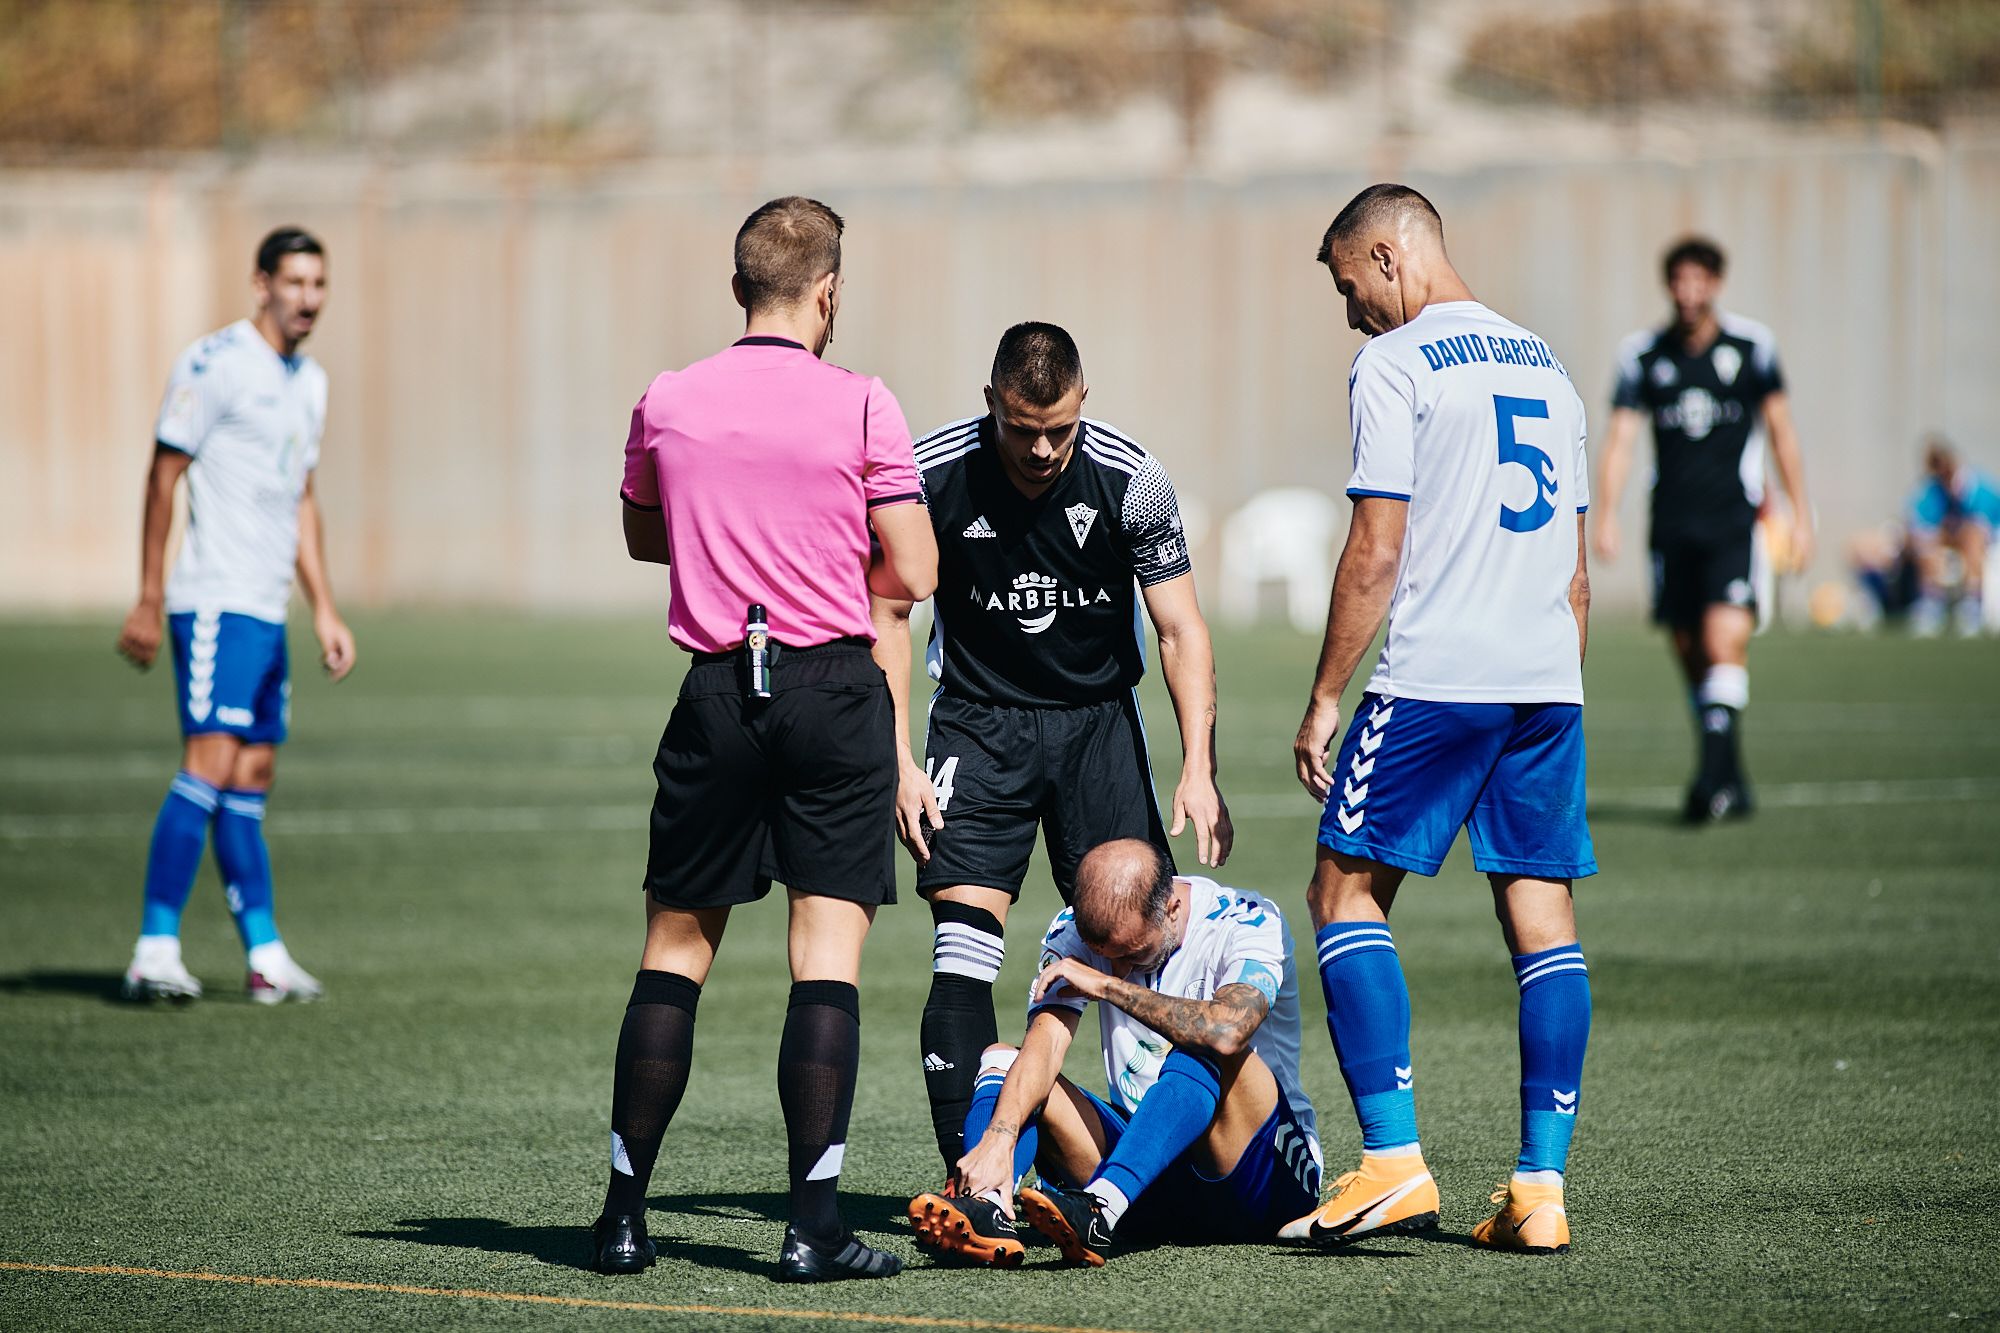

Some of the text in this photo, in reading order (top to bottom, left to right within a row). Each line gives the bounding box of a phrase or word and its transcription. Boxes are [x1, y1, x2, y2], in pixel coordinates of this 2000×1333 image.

[1419, 333, 1489, 371] DAVID
[1493, 394, 1558, 533] 5
[962, 529, 997, 539] adidas
[970, 585, 1111, 611] MARBELLA
